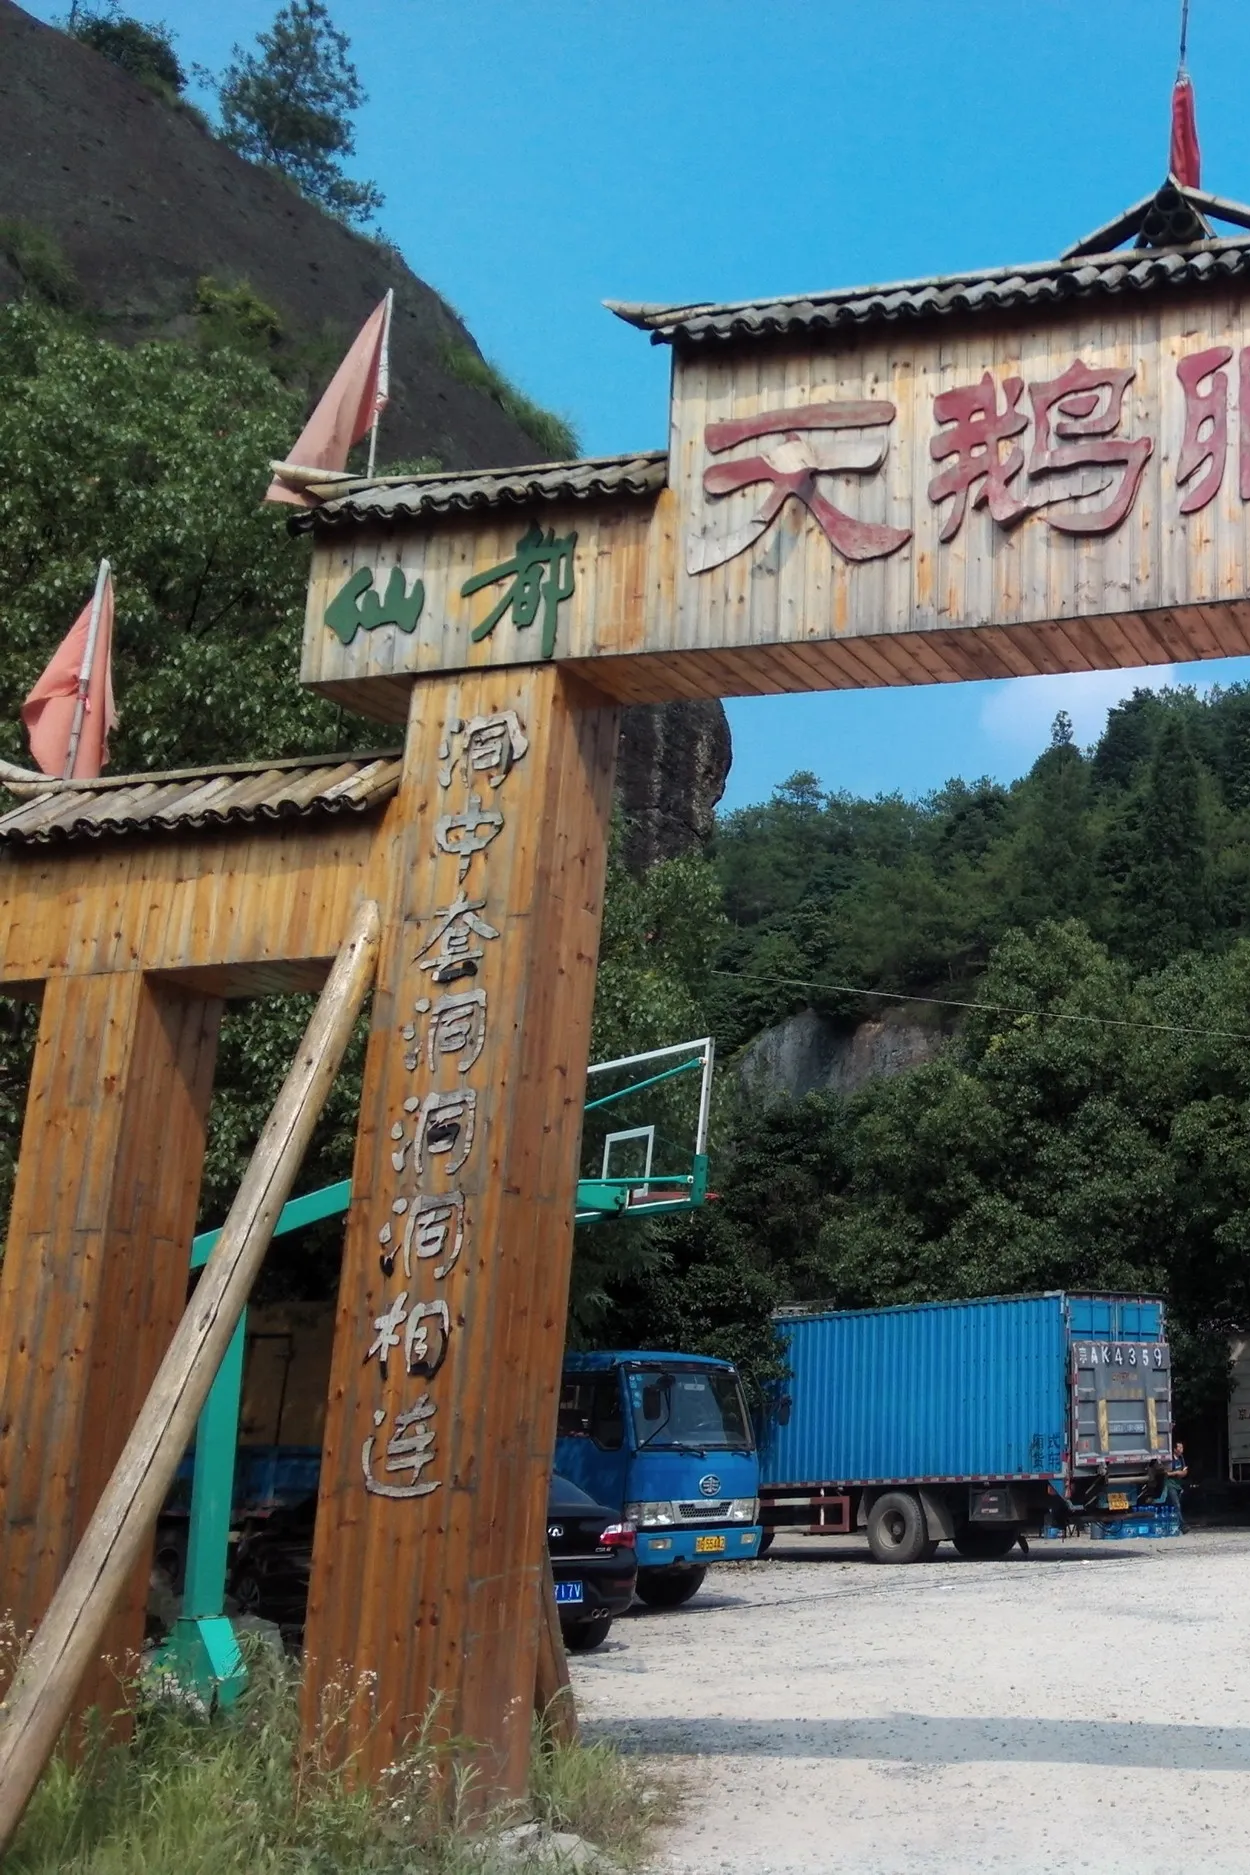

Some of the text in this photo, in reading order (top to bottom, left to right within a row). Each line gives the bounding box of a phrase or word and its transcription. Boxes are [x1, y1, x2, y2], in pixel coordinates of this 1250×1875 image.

[324, 519, 578, 658] 仙都
[361, 709, 529, 1499] 洞中套洞洞洞相连
